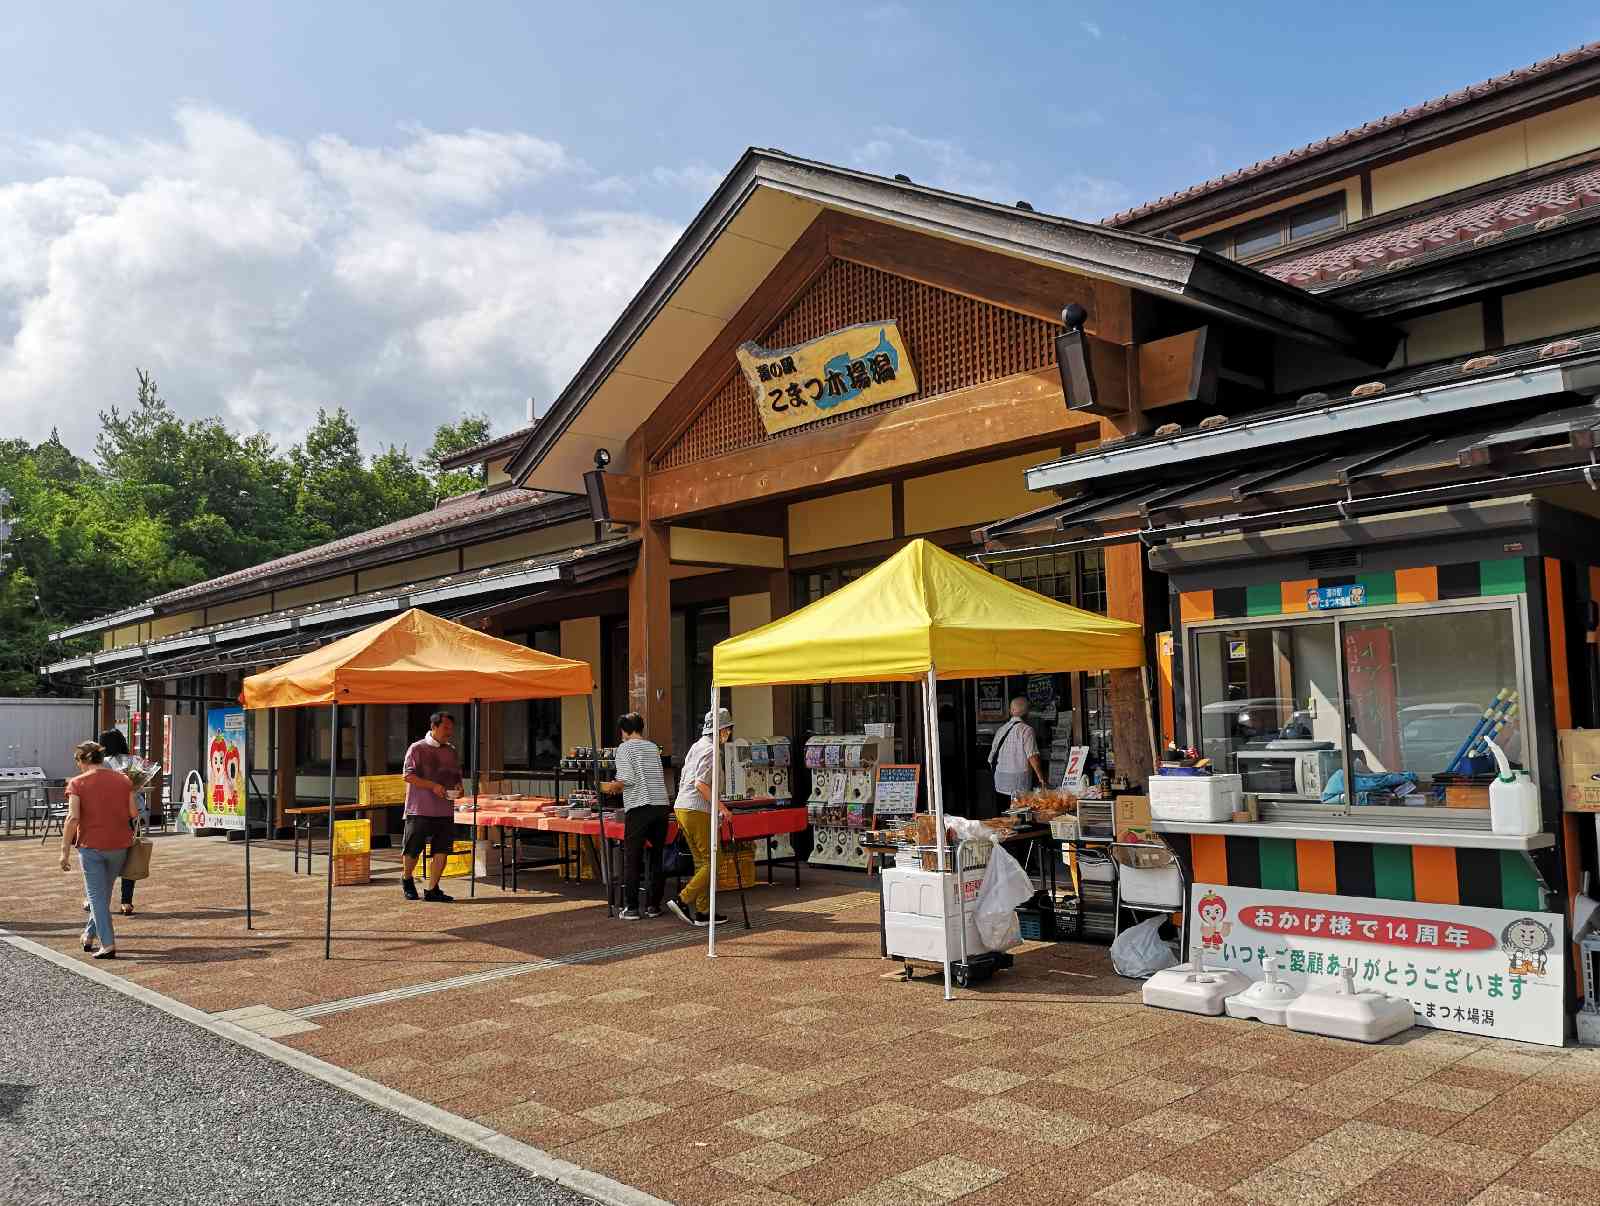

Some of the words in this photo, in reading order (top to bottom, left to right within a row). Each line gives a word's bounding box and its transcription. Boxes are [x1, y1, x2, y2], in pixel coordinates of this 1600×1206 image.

[1254, 908, 1470, 948] おかげ様で14周年
